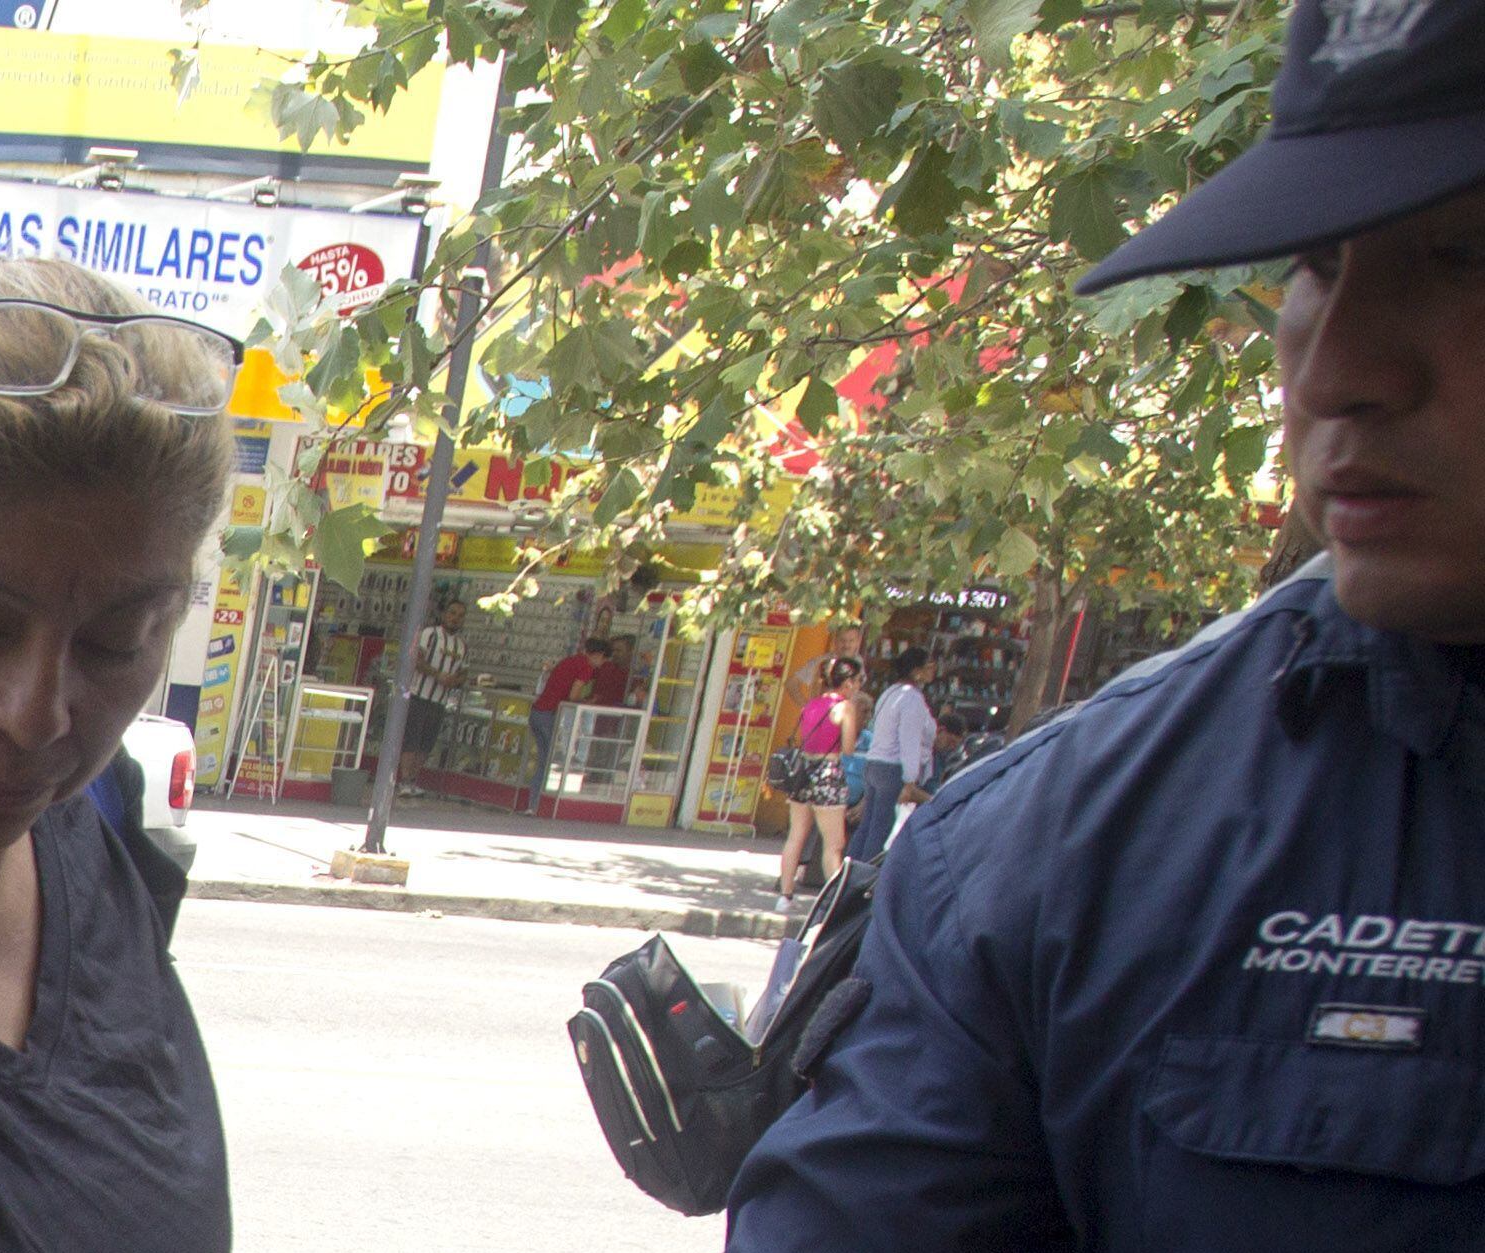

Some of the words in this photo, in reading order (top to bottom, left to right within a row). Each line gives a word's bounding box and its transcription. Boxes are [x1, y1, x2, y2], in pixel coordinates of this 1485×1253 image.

[57, 215, 265, 286] SIMILARES
[310, 245, 350, 266] HASTA
[1258, 911, 1485, 955] CADET
[1242, 947, 1485, 986] MONTERRE
